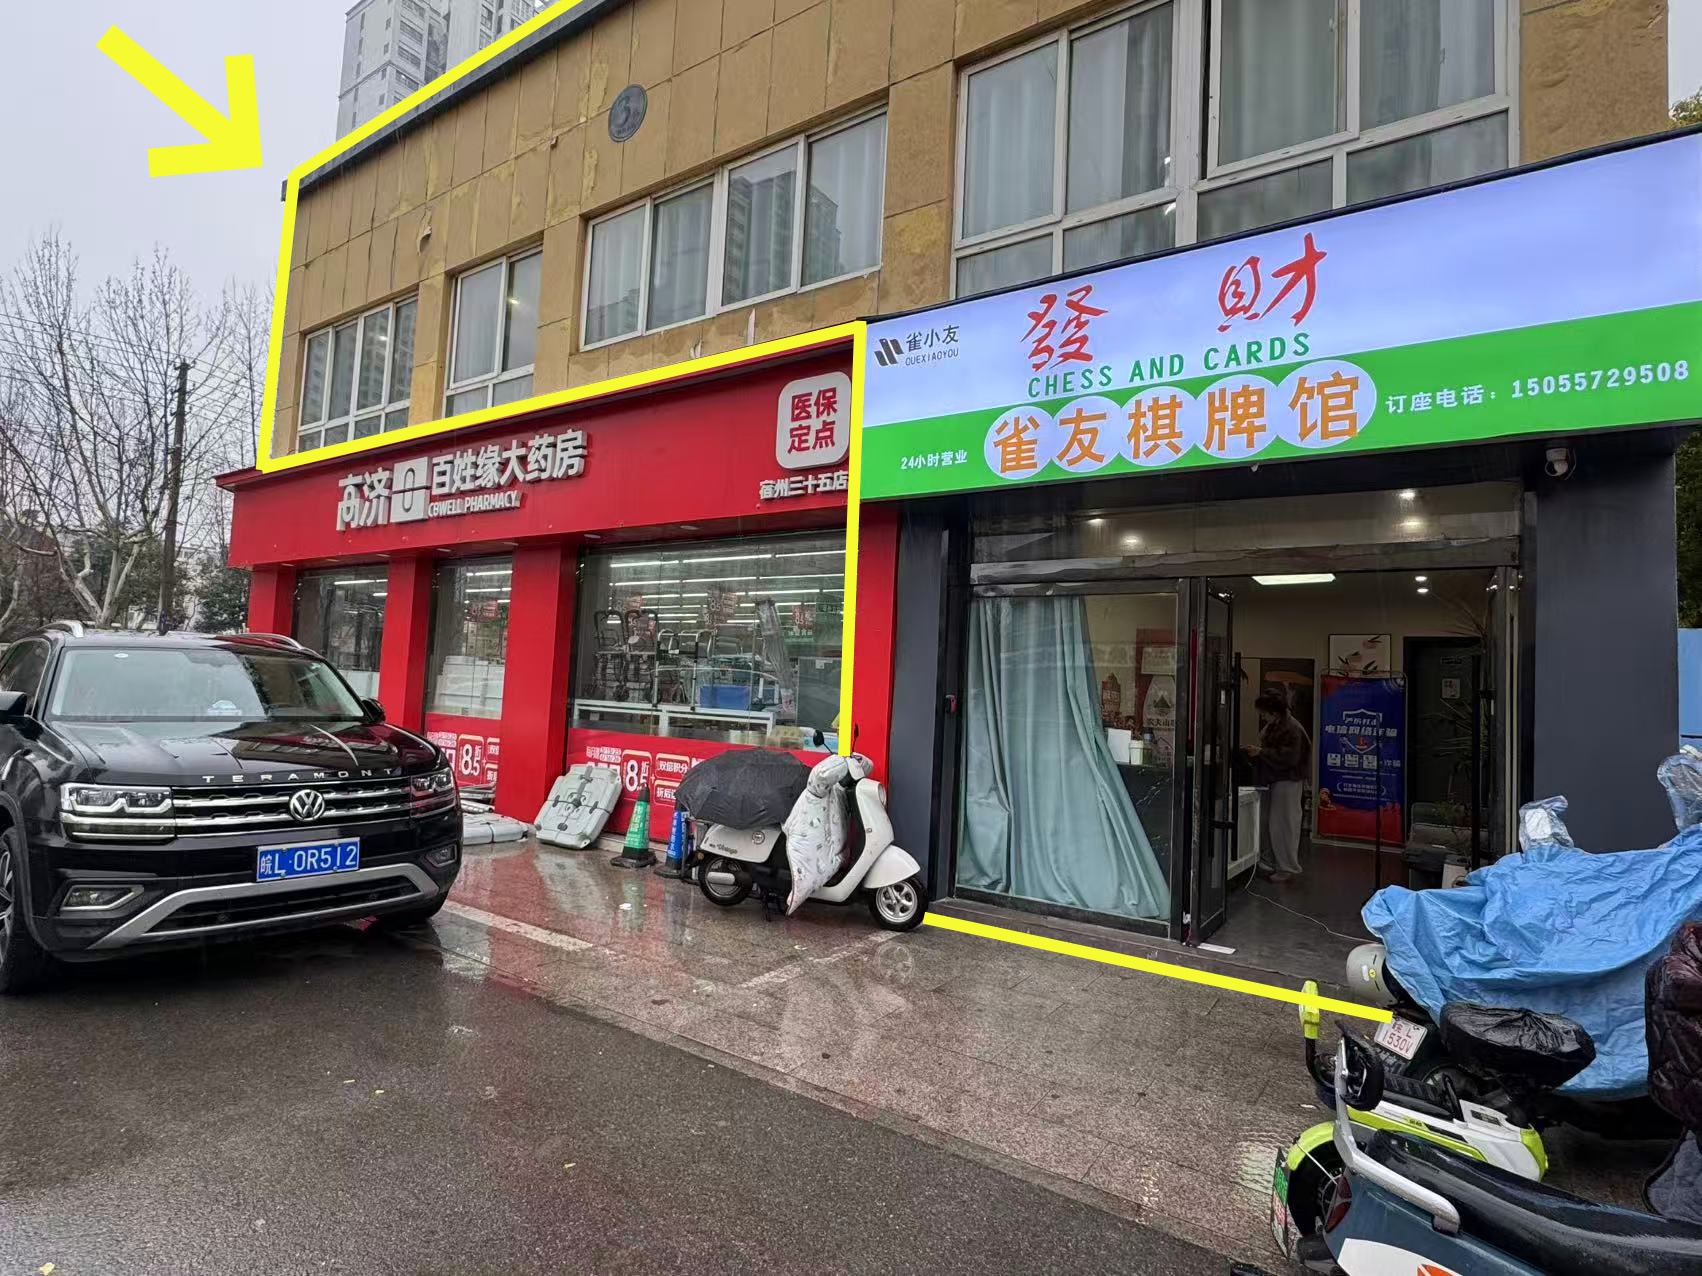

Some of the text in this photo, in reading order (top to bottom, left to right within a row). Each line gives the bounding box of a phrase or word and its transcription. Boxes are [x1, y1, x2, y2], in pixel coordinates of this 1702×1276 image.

[906, 324, 960, 352] 雀小友
[1027, 331, 1311, 399] CHESS AND CARDS
[1511, 359, 1690, 399] 15055729508
[790, 386, 837, 422] 医保
[787, 420, 836, 455] 定点
[992, 370, 1360, 474] 雀友棋牌馆
[431, 429, 588, 496] 百姓缘大药房
[900, 448, 968, 470] 24小时营业
[464, 489, 520, 514] PHARMACY
[759, 470, 849, 500] 宿州三十五店
[202, 768, 393, 784] TERAMONT
